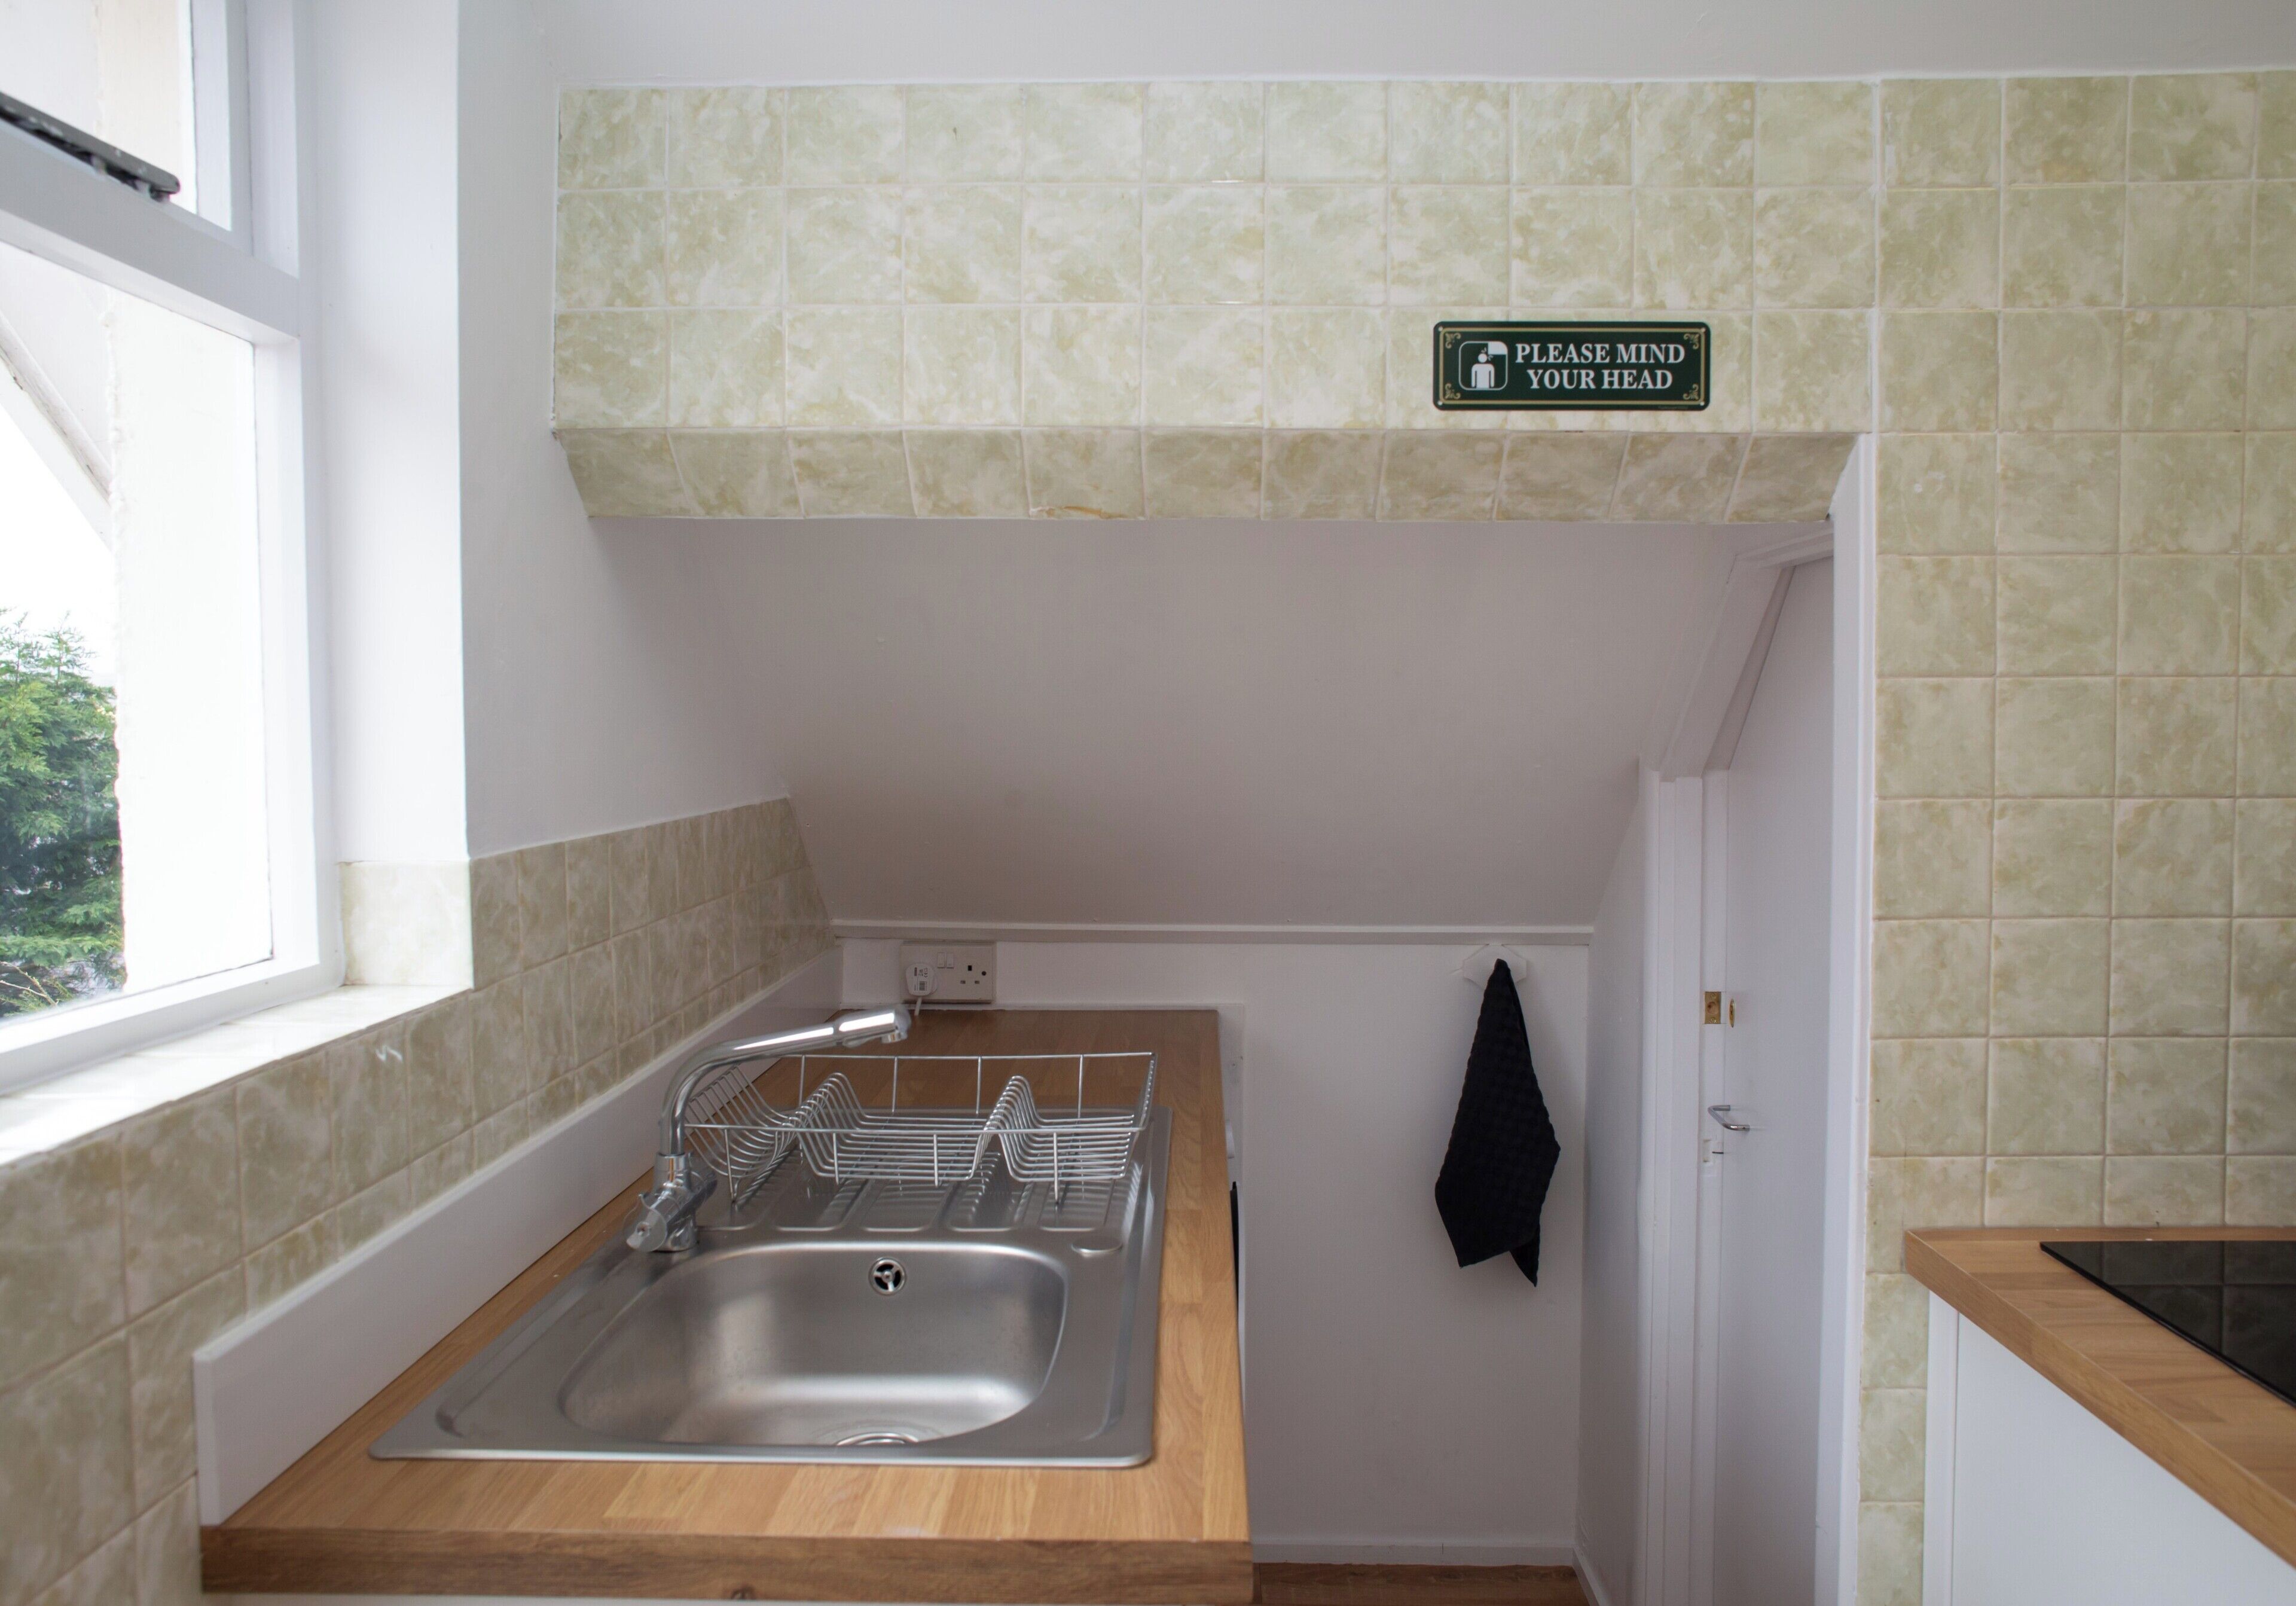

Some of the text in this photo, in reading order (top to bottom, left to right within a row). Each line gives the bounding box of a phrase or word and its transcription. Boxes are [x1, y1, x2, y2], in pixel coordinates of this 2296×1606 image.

[1515, 343, 1685, 364] PLEASE MIND
[1526, 369, 1673, 389] YOUR HEAD
